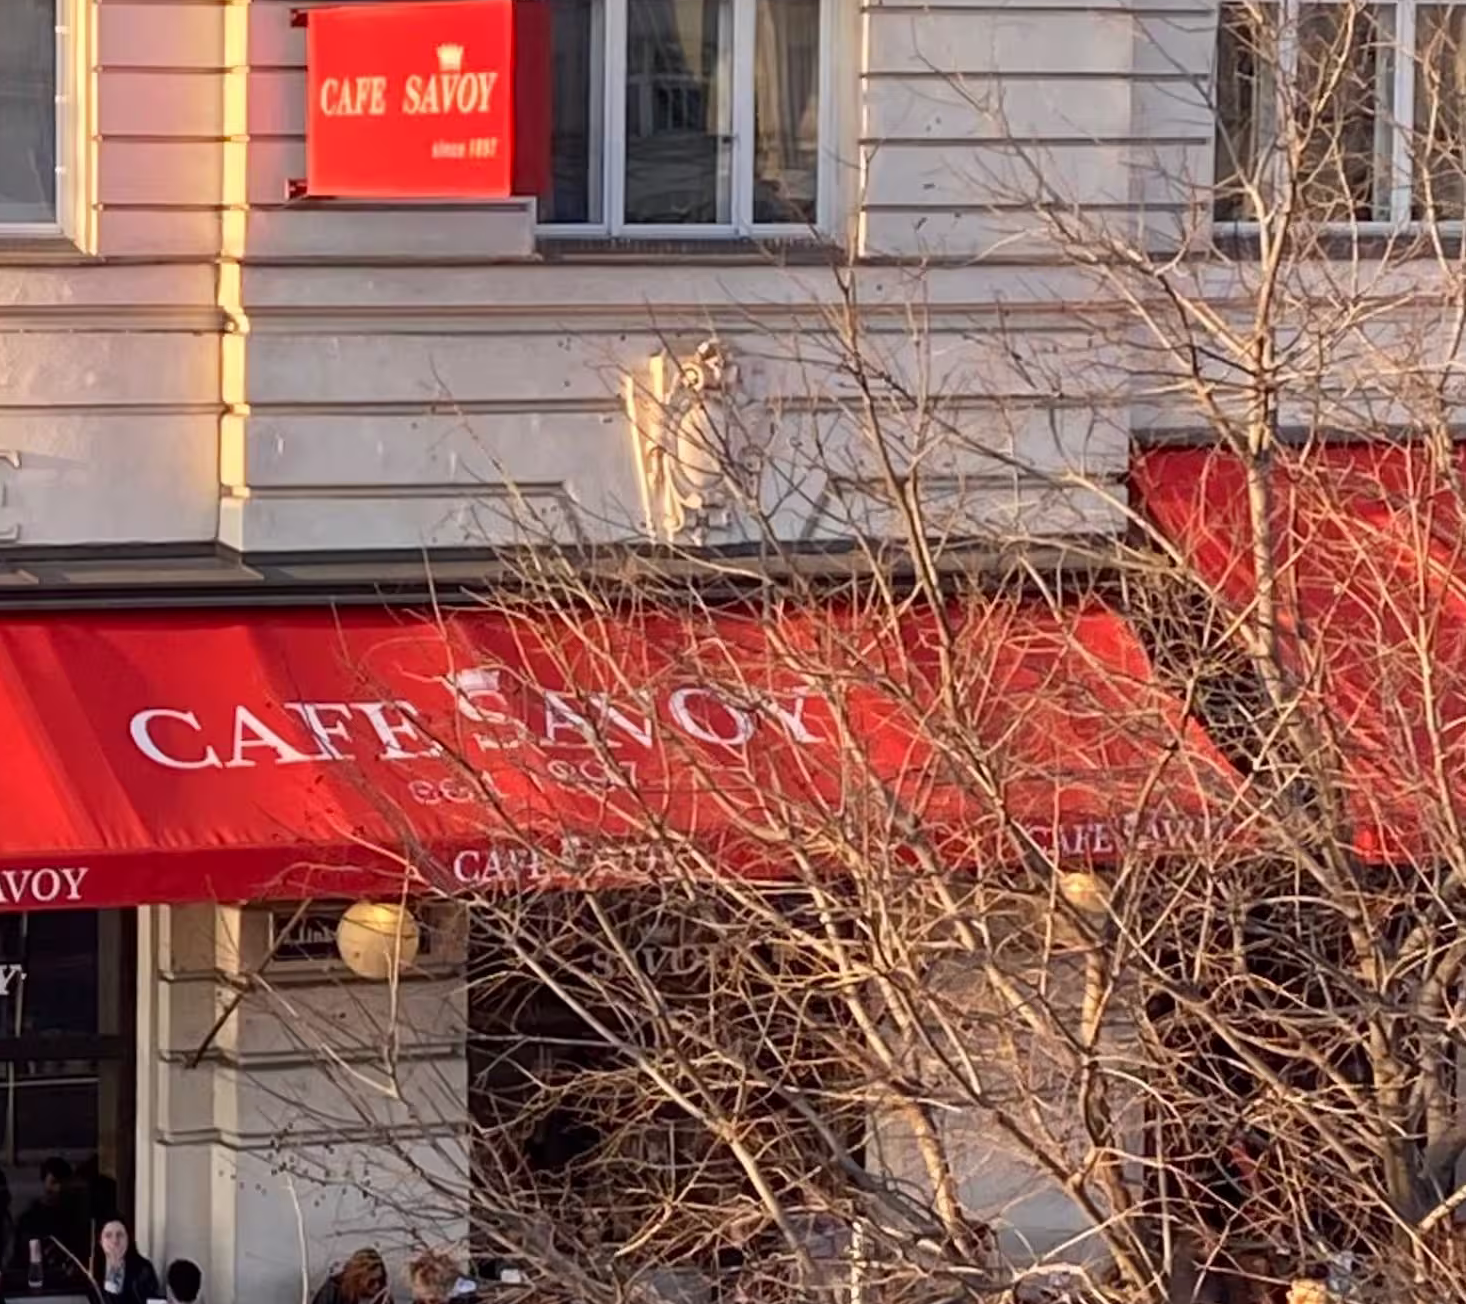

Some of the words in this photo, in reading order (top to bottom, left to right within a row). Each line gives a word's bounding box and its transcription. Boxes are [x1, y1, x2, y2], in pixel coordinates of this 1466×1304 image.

[320, 76, 387, 116] CAFE
[402, 71, 498, 115] SAVOY
[128, 699, 444, 771] CAFE
